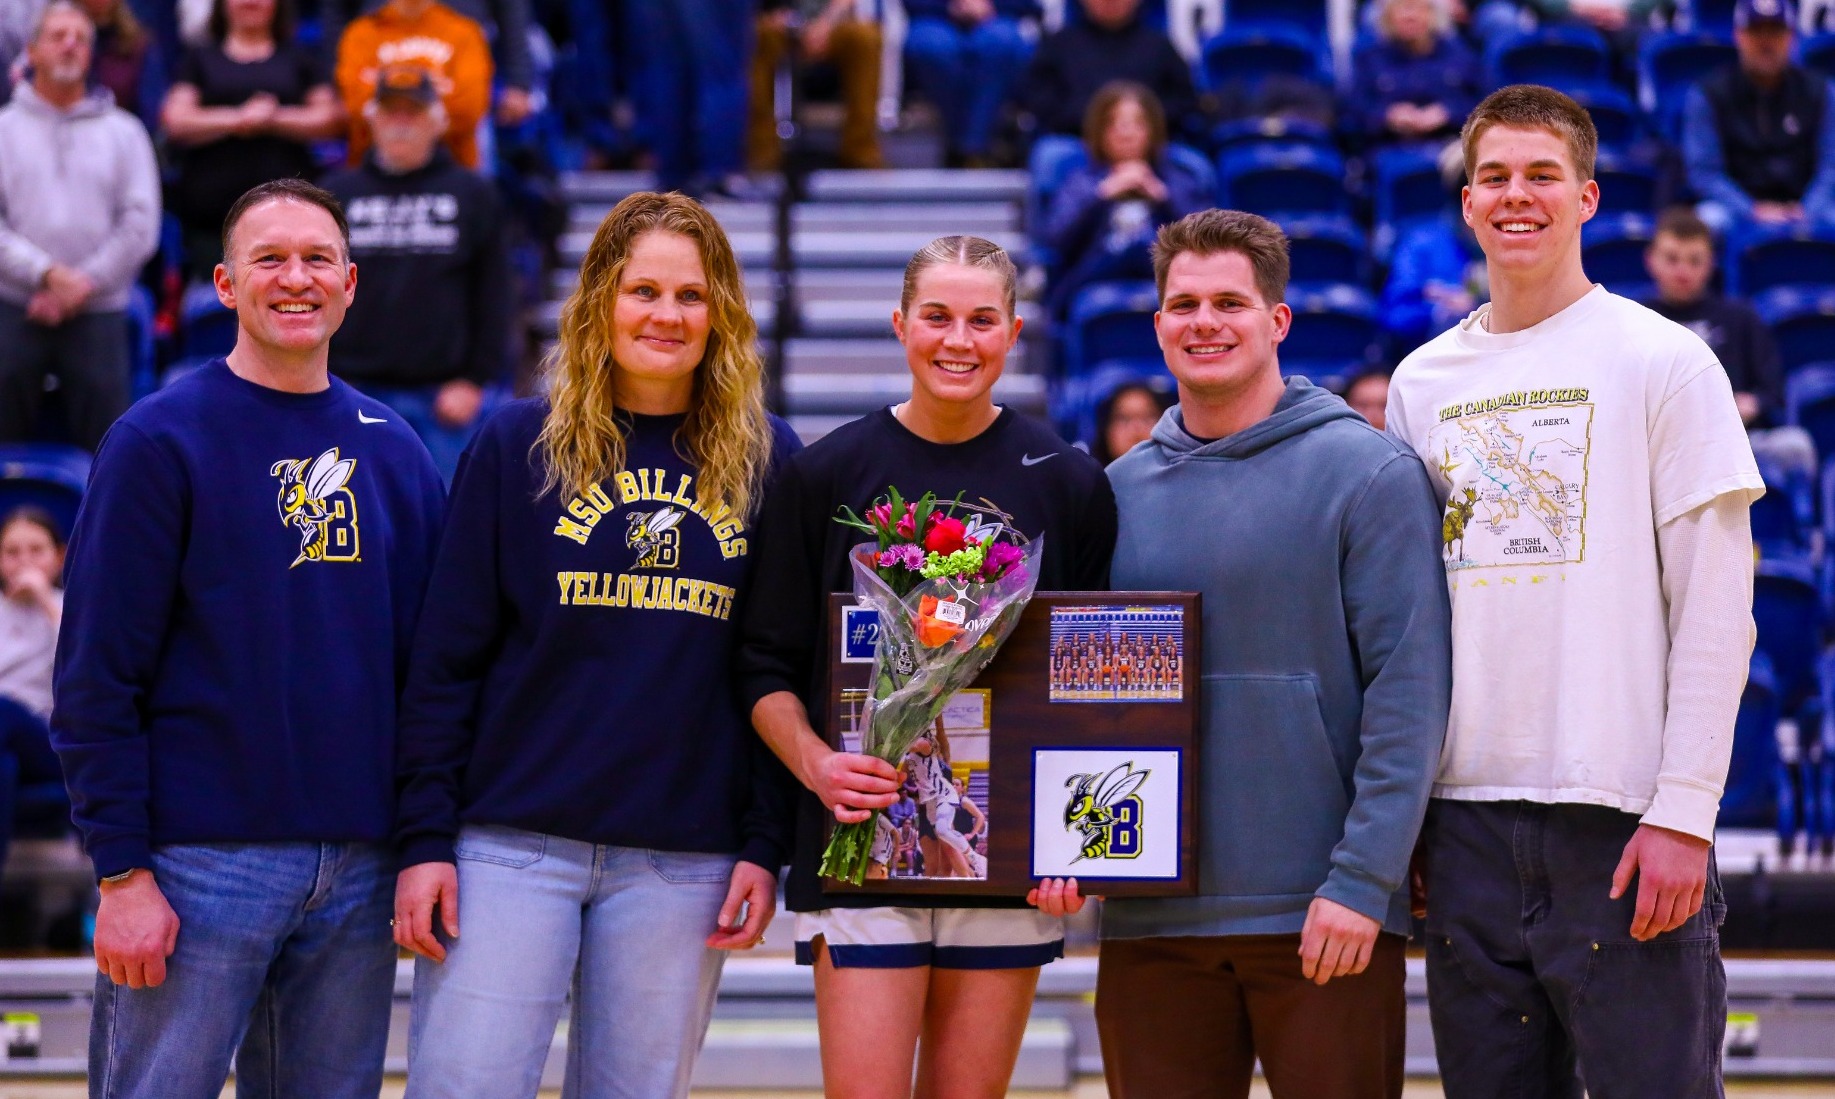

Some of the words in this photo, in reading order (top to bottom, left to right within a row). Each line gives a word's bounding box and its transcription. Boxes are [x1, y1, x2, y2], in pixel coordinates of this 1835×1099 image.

[1439, 404, 1462, 422] THE
[1529, 387, 1589, 404] ROCKIES
[1531, 417, 1570, 427] ALBERTA
[553, 482, 615, 546] MSU
[1503, 545, 1549, 555] COLUMBIA
[1509, 537, 1541, 546] BRITISH
[557, 571, 736, 620] YELLOWJACKETS
